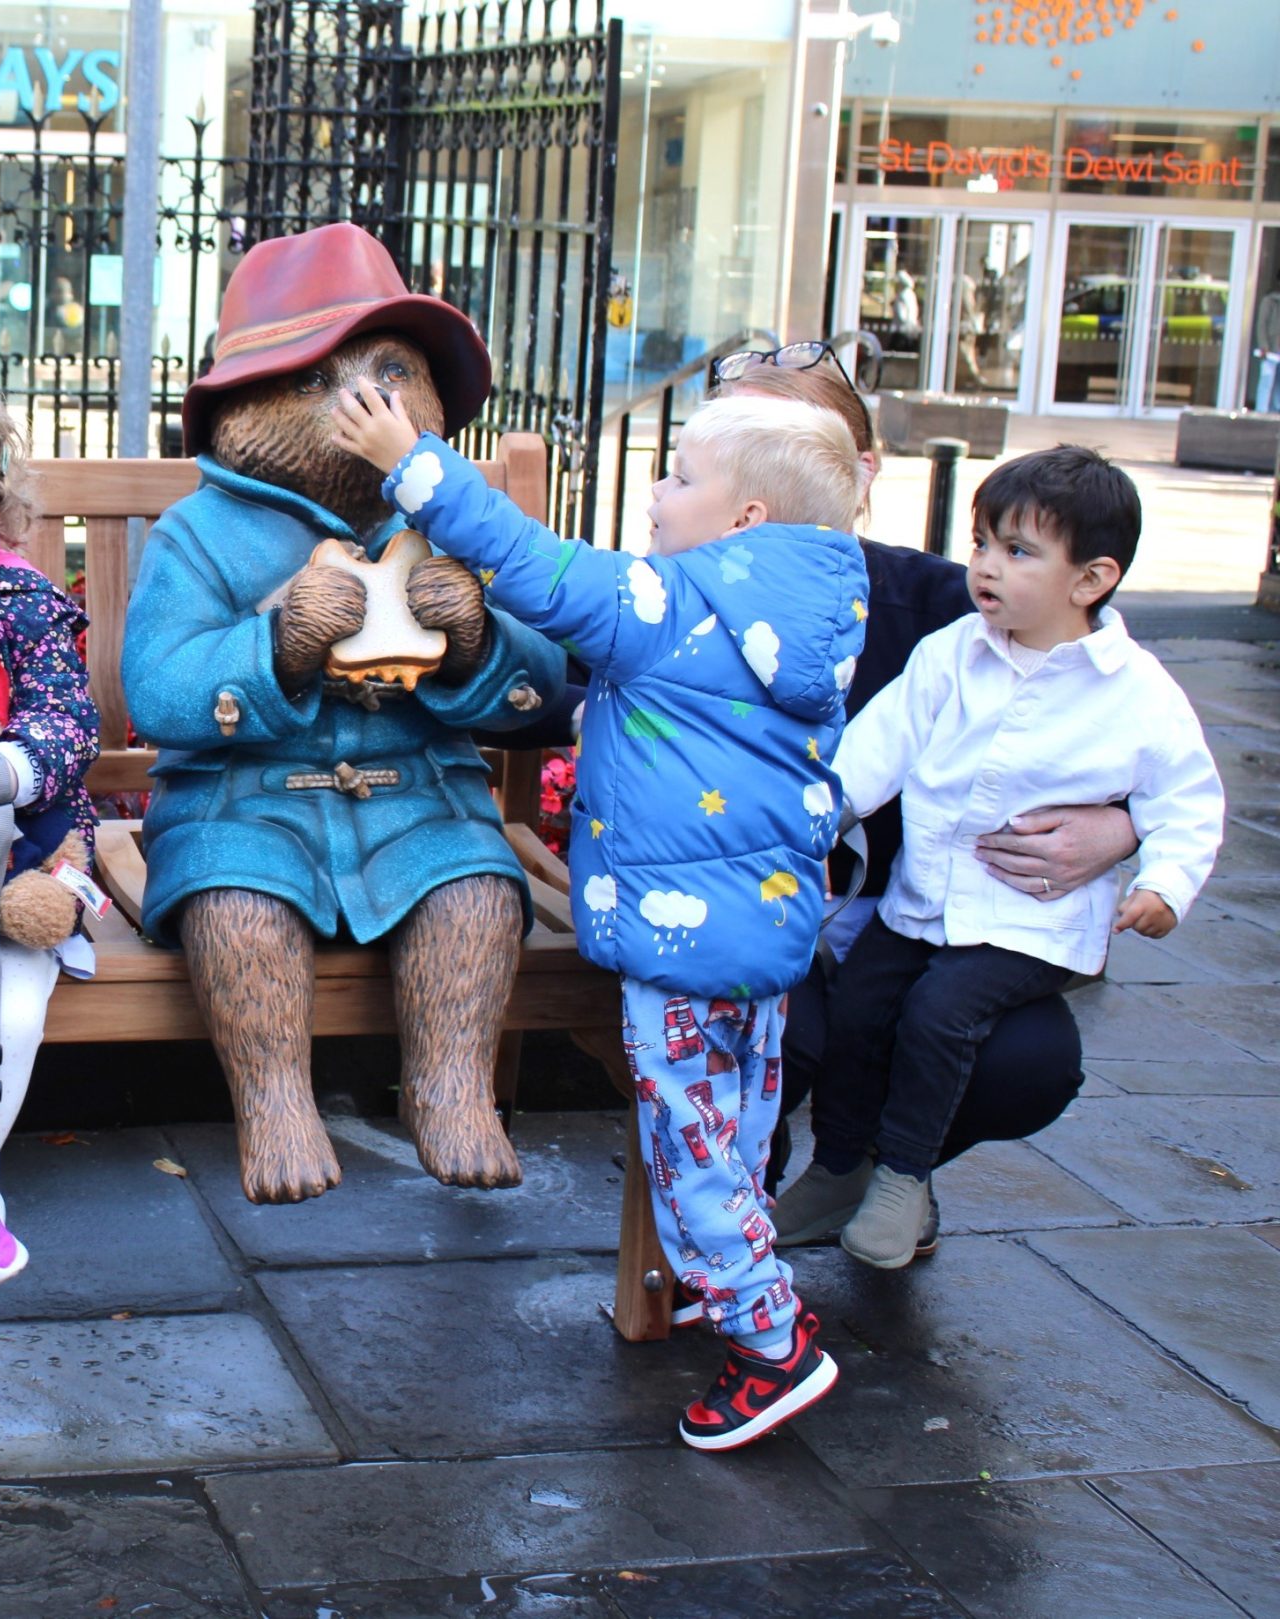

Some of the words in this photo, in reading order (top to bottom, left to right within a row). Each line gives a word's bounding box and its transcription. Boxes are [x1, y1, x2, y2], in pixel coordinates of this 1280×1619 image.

[879, 138, 916, 173] St
[926, 140, 1051, 178] David's
[1065, 147, 1154, 182] Dewi
[1161, 151, 1243, 188] Sant
[17, 742, 42, 796] FROZEN
